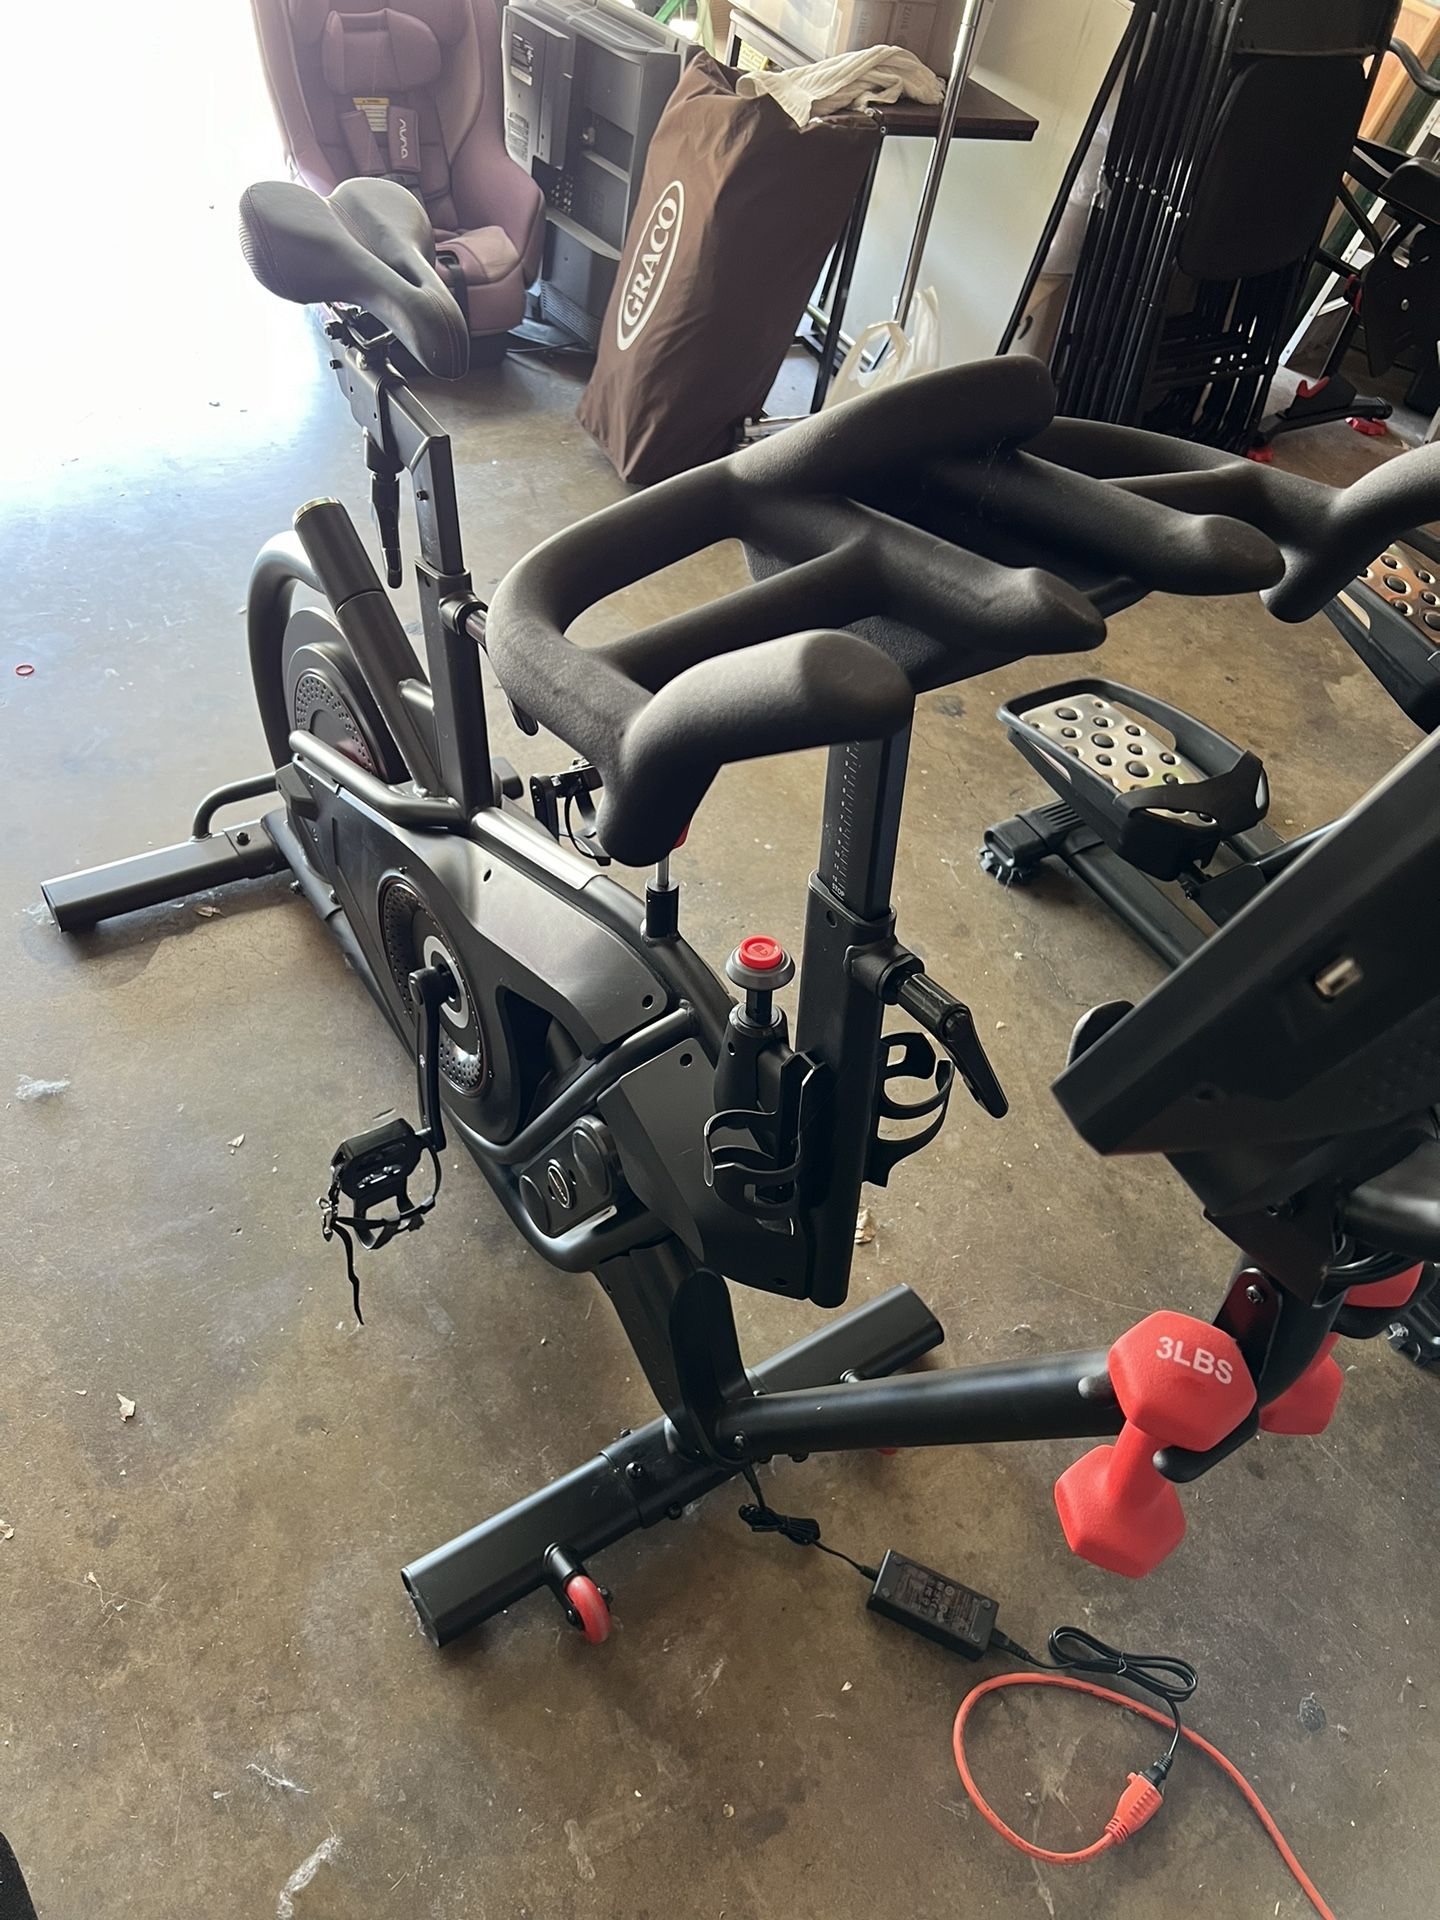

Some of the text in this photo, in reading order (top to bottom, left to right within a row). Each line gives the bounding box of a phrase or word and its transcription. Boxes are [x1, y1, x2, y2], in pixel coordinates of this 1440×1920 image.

[623, 198, 678, 326] GRACO
[832, 882, 846, 897] STOP
[1155, 1336, 1233, 1385] 3LBS
